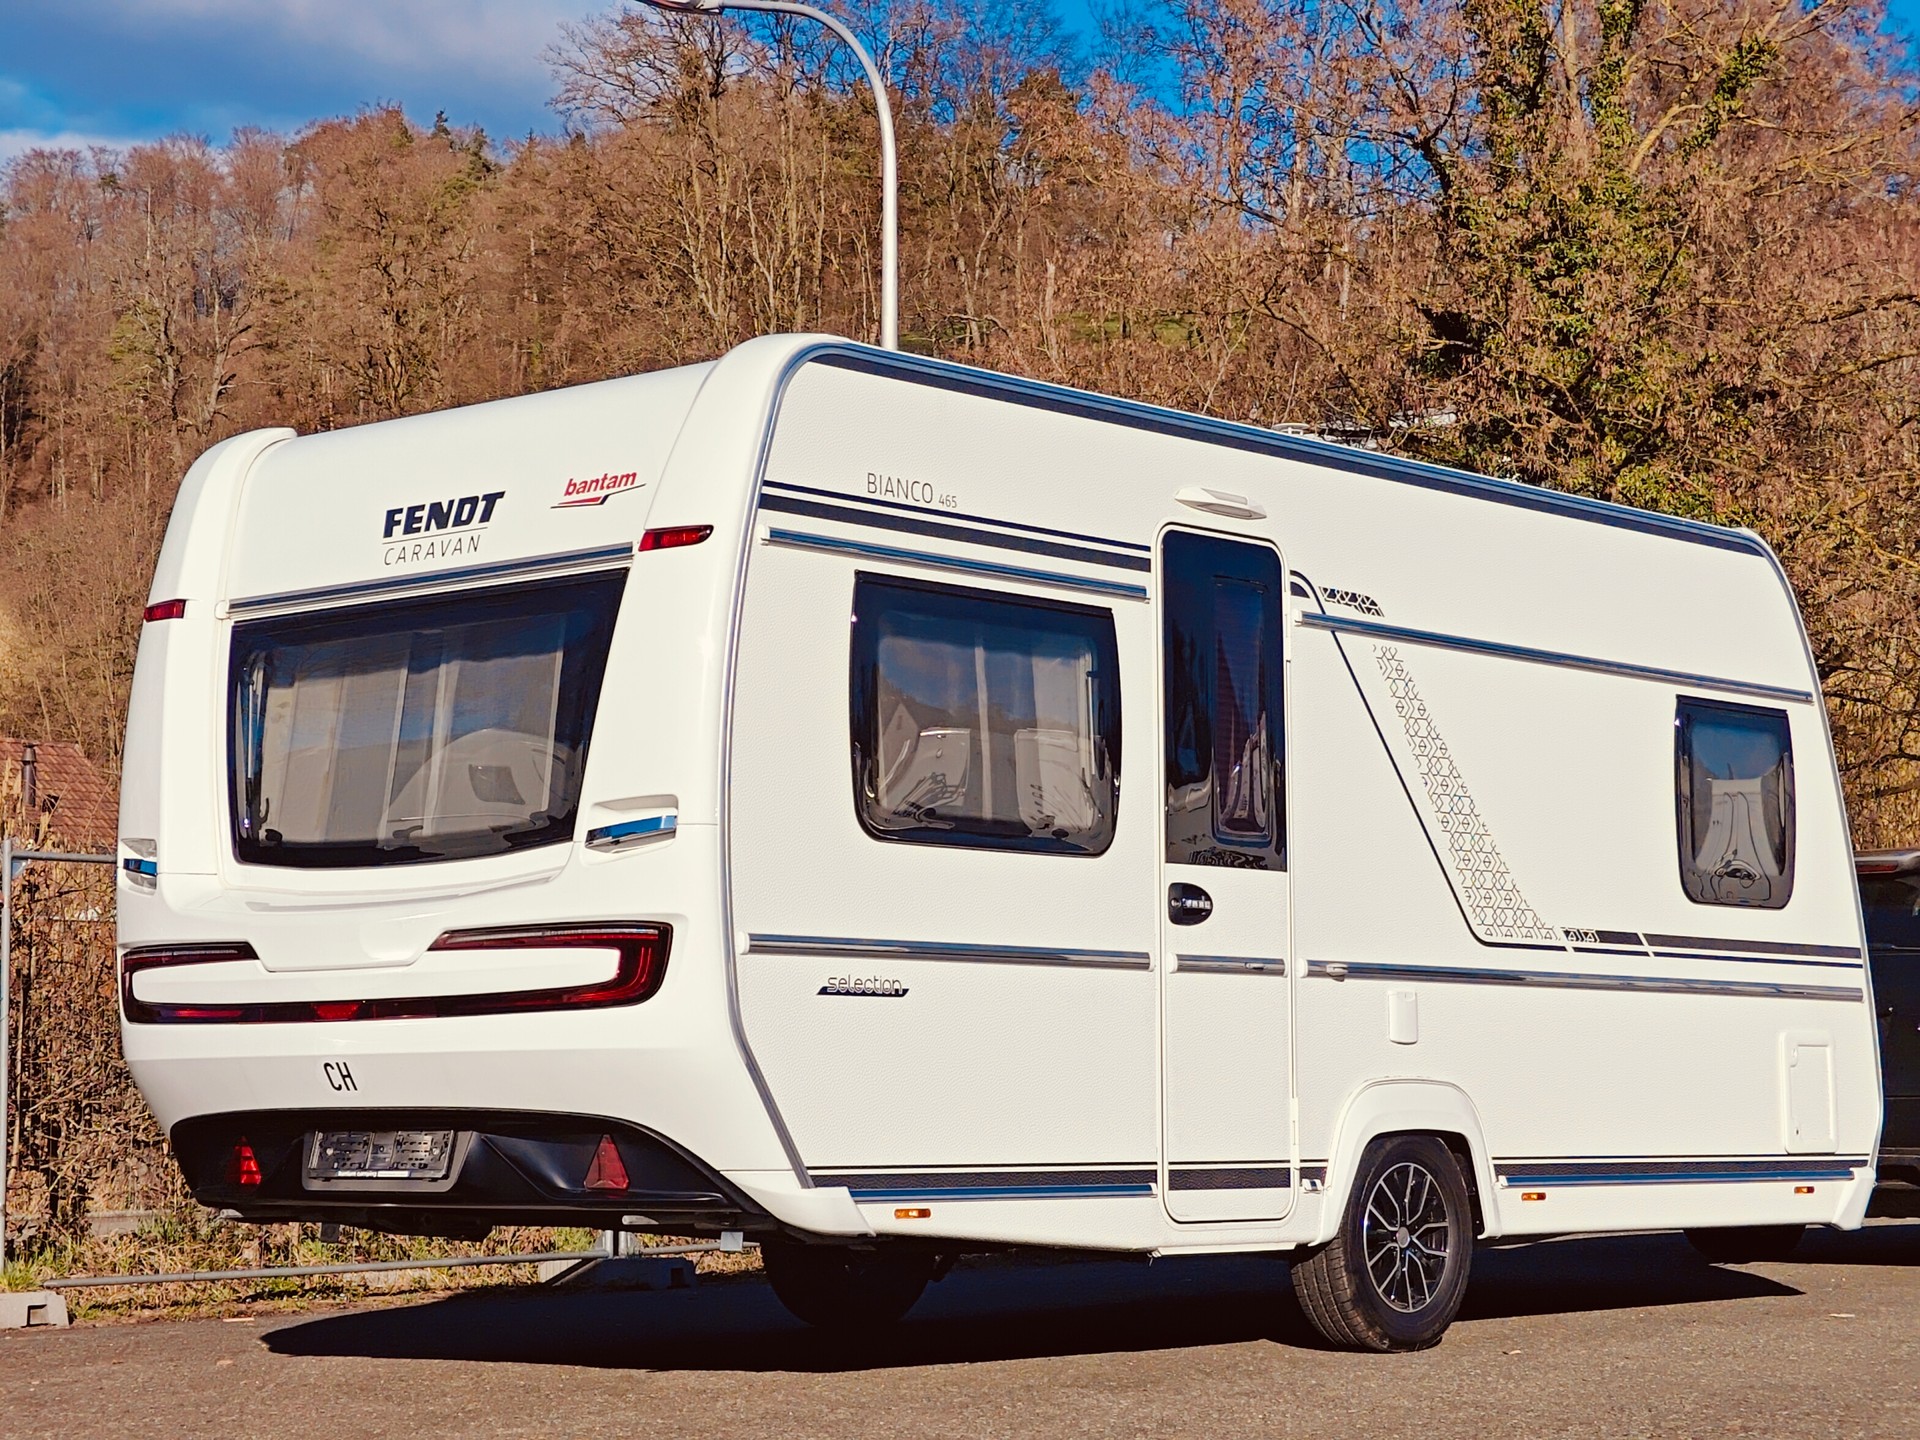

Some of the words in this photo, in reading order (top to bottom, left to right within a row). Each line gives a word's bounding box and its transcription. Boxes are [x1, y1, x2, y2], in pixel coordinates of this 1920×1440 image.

[564, 472, 637, 496] bantam
[867, 473, 933, 503] BIANCO
[939, 494, 957, 508] 465
[383, 490, 506, 539] FENDT
[384, 534, 480, 566] CARAVAN
[827, 974, 903, 994] selection
[324, 1062, 358, 1091] CH
